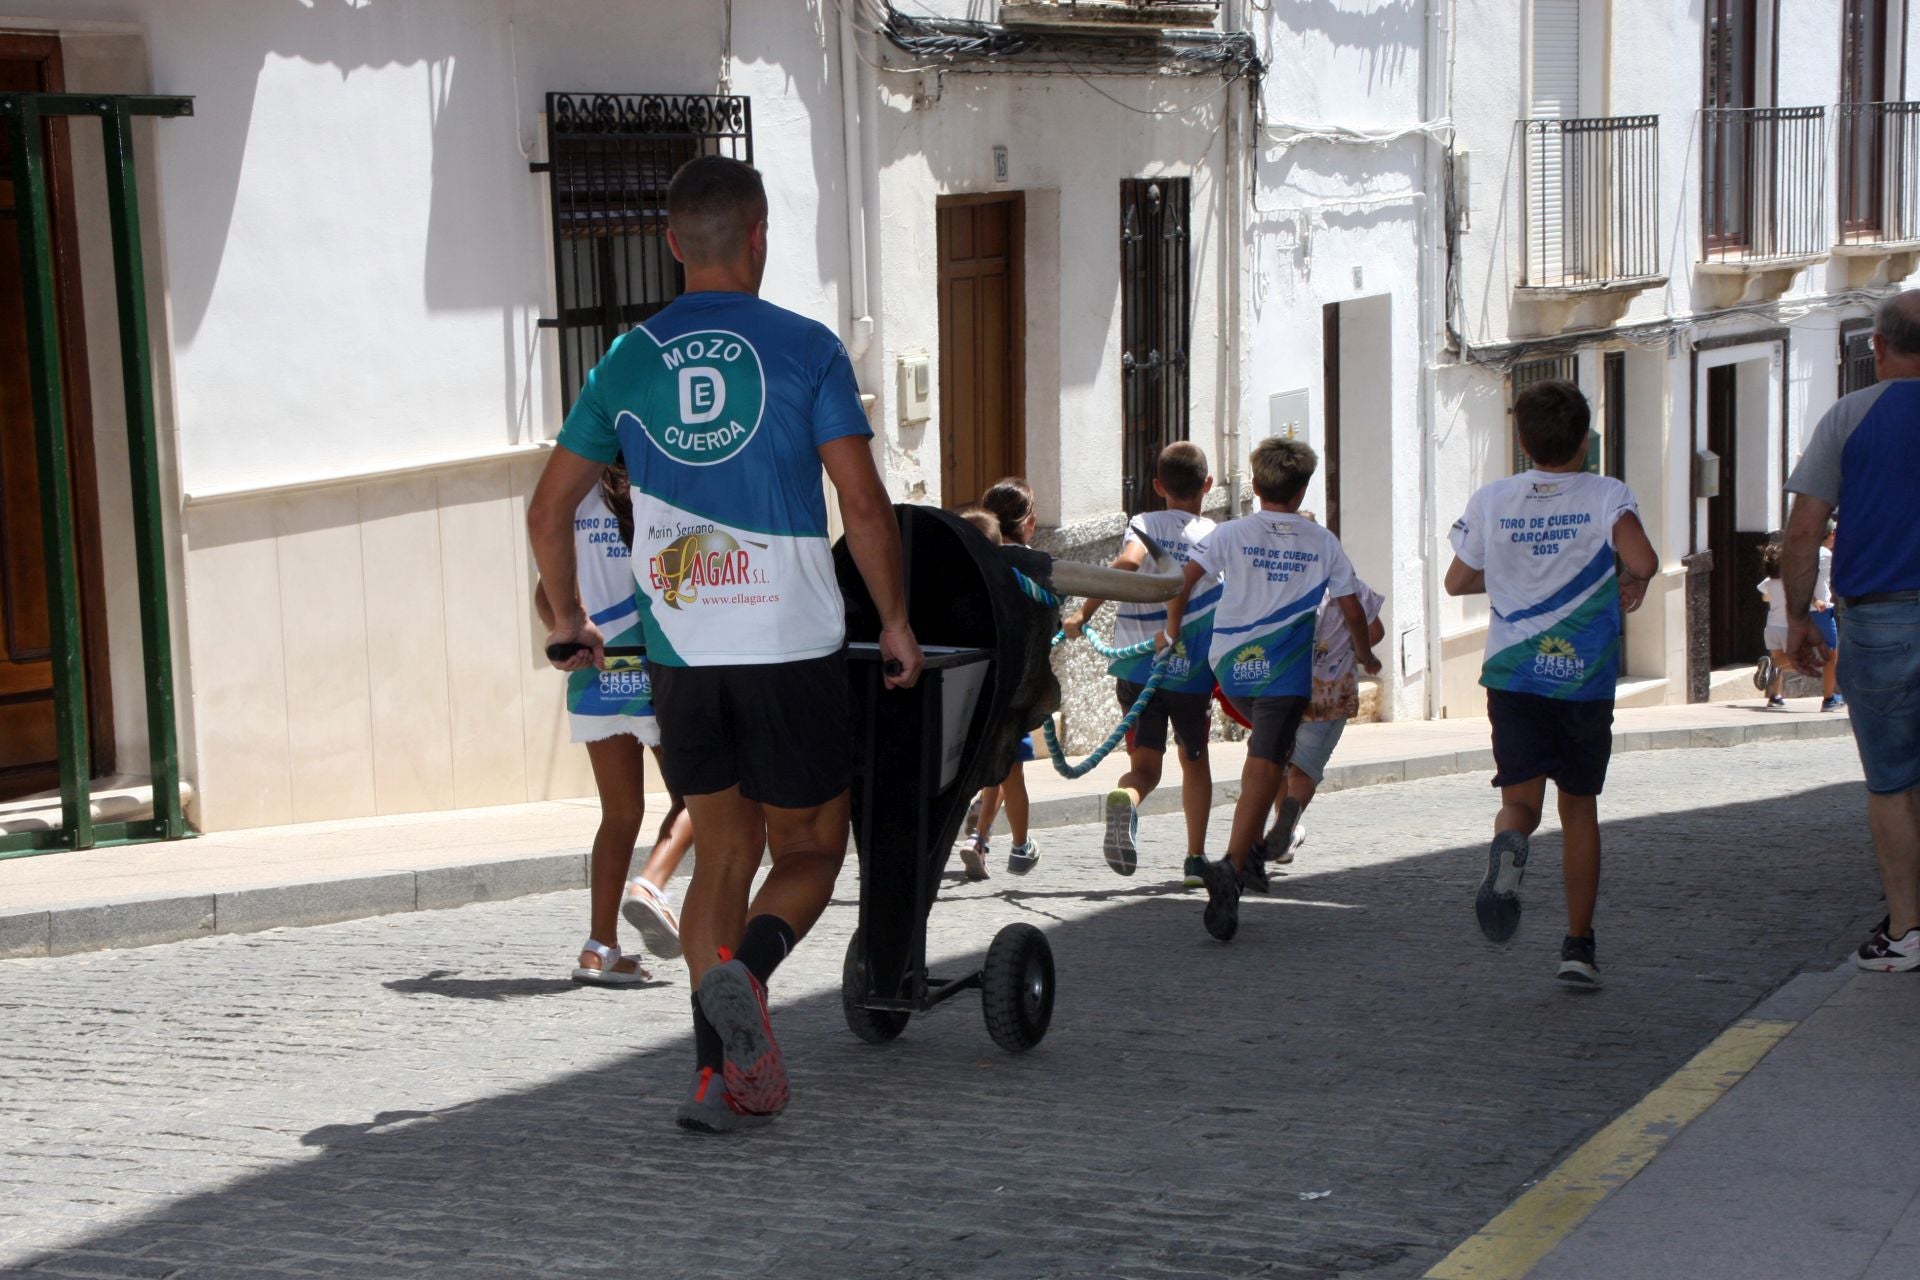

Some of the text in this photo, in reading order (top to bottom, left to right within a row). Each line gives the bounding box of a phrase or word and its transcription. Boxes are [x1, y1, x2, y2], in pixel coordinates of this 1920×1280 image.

[662, 339, 742, 370] MOZO
[664, 420, 746, 451] CUERDA
[575, 518, 620, 531] TORO DE
[1499, 513, 1591, 529] TORO DE CUERDA
[676, 522, 715, 537] Serrano
[1511, 528, 1577, 543] CARCABUEY
[1177, 543, 1189, 552] DE
[1242, 547, 1319, 562] TORO DE CUERDA
[1532, 543, 1559, 556] 2025
[1253, 558, 1306, 573] CARCABUEY
[753, 568, 770, 584] S.L.
[1267, 572, 1288, 582] 2025
[702, 593, 780, 606] www.ellagar.es
[1233, 660, 1270, 672] GREEN
[1535, 653, 1584, 669] GREEN
[599, 671, 650, 683] GREEN
[1233, 669, 1270, 680] CROPS
[1534, 663, 1584, 679] CROPS
[600, 682, 652, 694] CROPS
